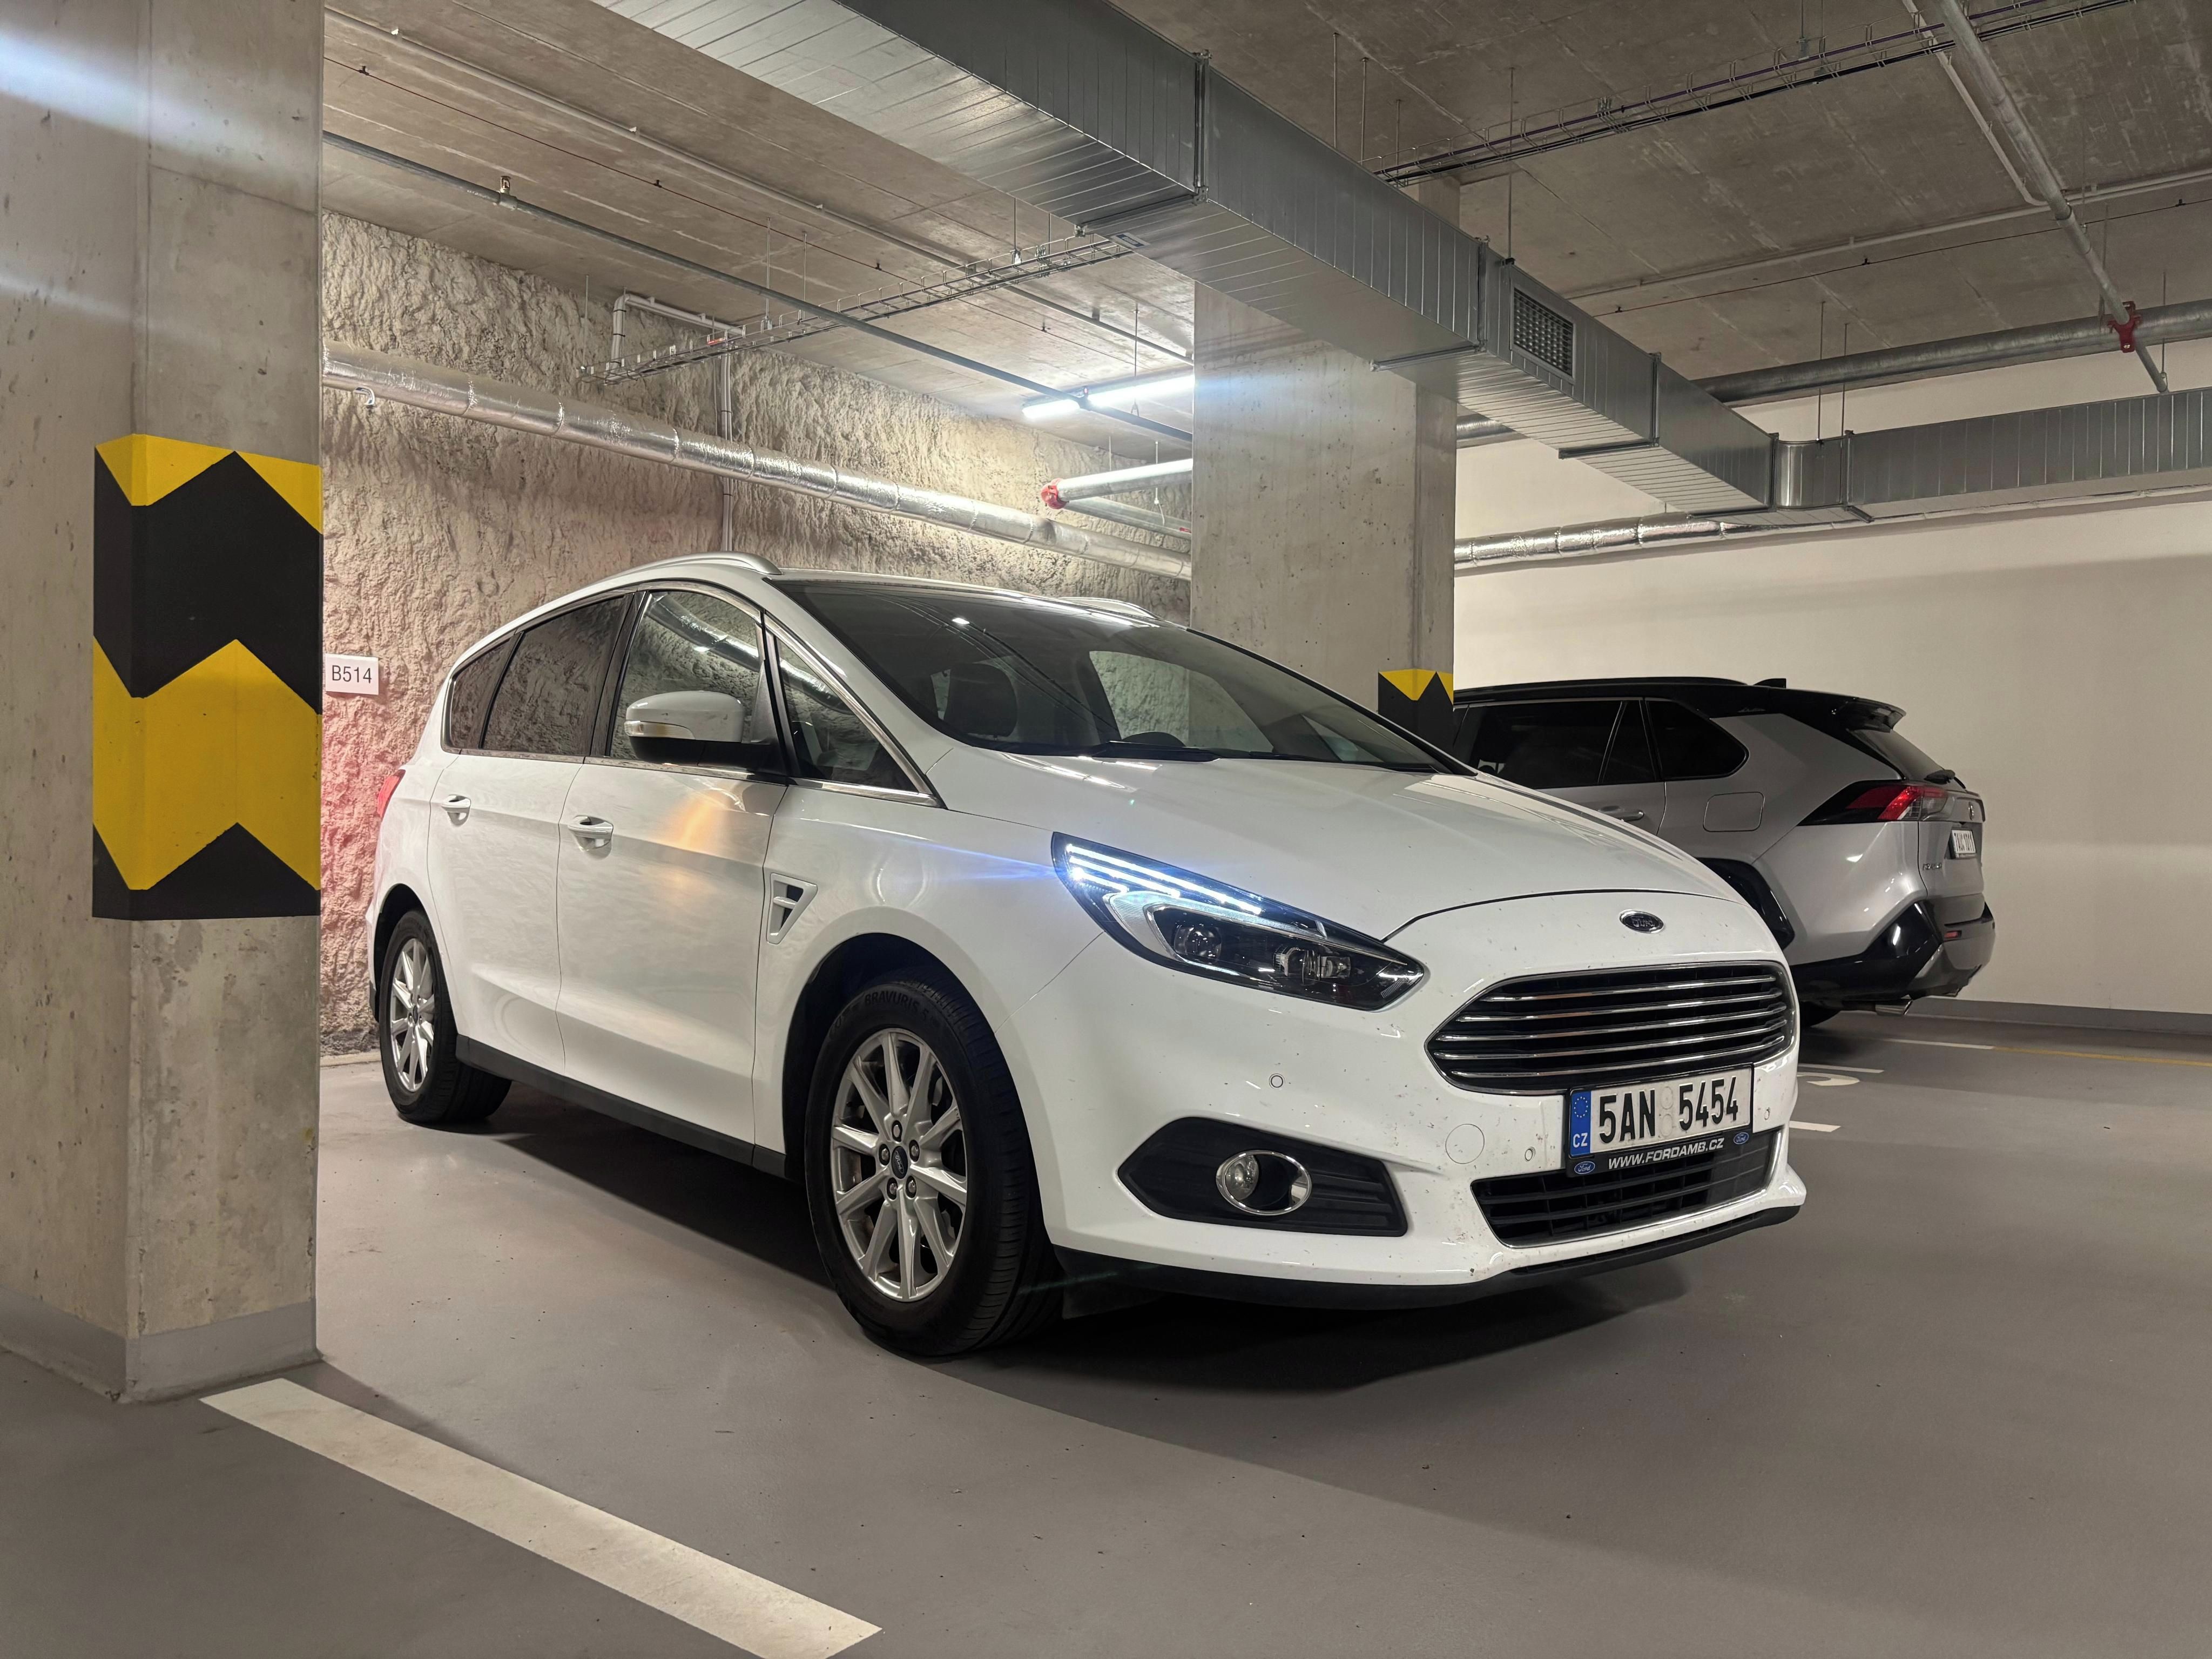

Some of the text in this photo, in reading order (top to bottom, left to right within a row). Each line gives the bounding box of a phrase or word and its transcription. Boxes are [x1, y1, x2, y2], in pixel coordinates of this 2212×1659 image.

[332, 665, 372, 684] B514
[865, 990, 920, 1011] BRAVURIS
[1599, 1076, 1738, 1143] 5AN 5454
[1573, 1132, 1588, 1148] CZ
[1609, 1137, 1724, 1169] WWW.FORDAMB.CZ
